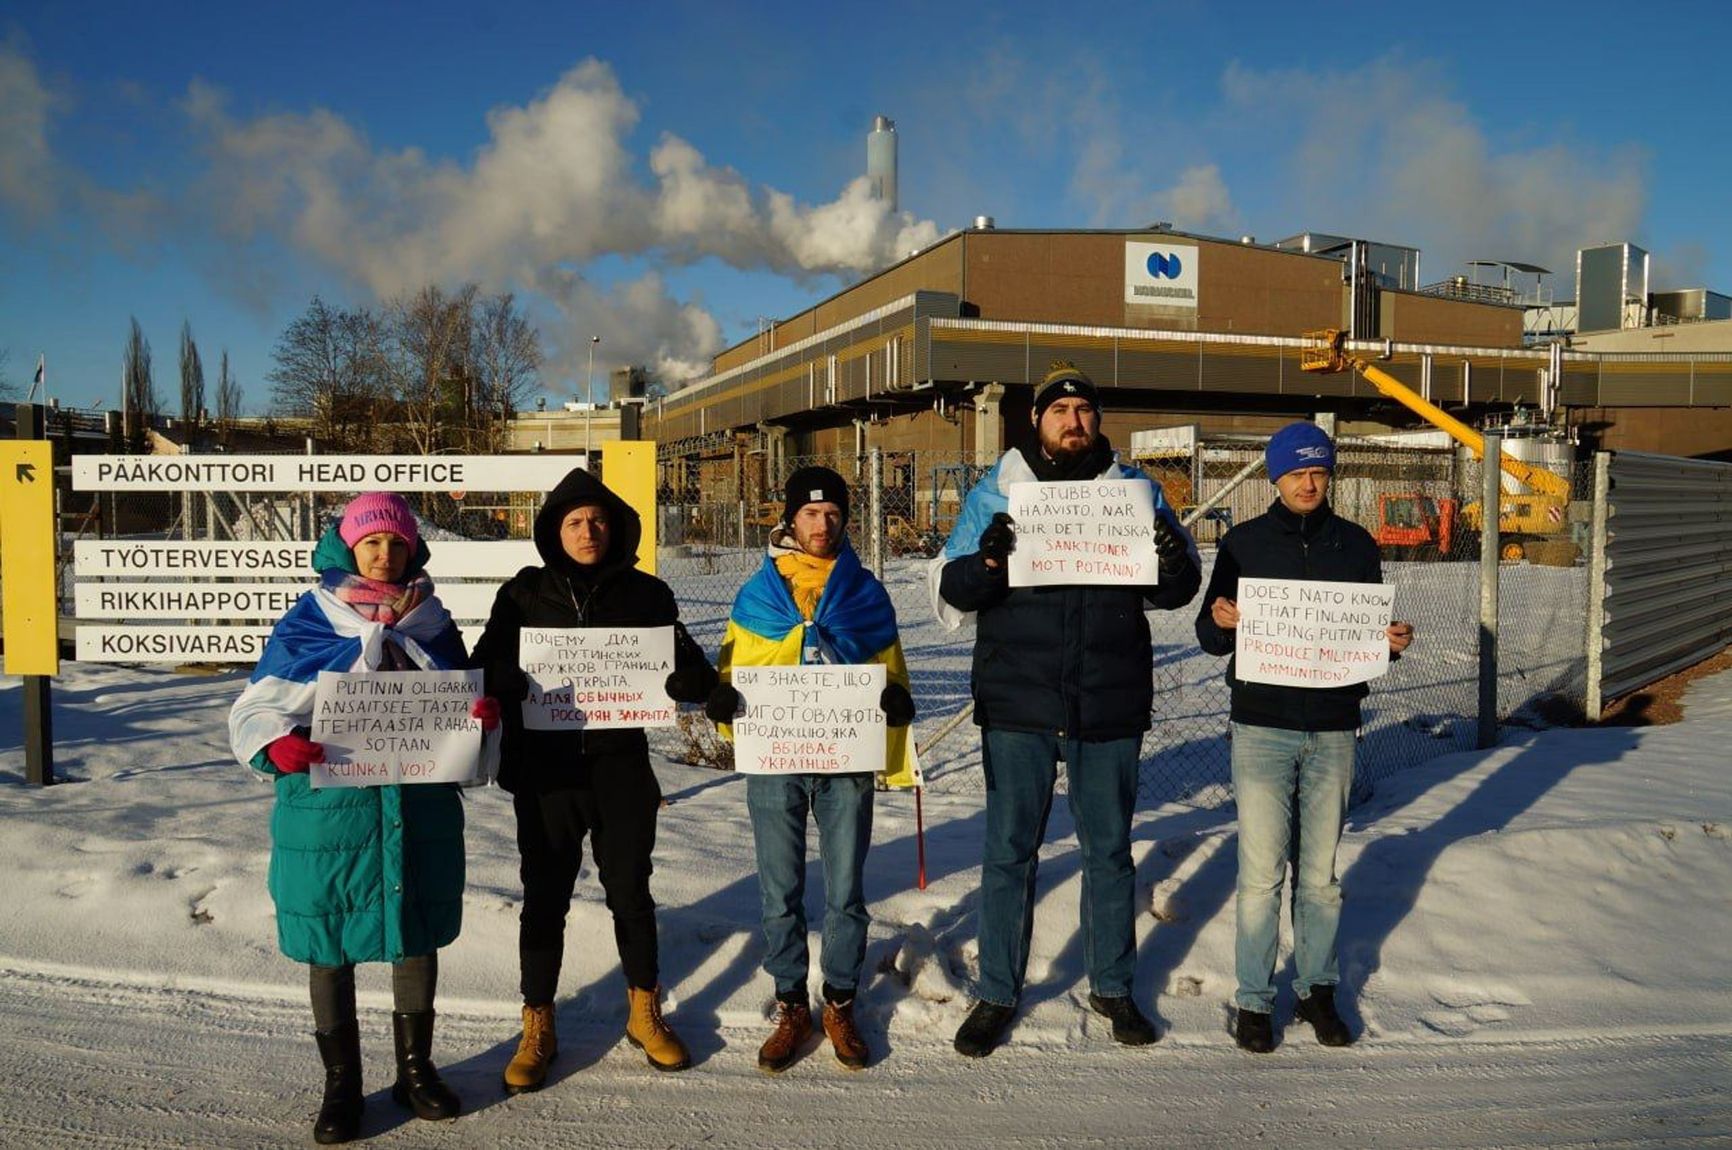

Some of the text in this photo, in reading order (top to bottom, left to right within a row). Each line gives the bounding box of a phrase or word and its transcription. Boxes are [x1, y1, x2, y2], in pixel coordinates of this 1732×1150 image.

[98, 457, 464, 482] PÄÄKONTTORI HEAD OFFICE
[1040, 485, 1127, 501] STUBB OCH
[1055, 523, 1085, 535] DET
[1098, 522, 1150, 537] FINSKA
[1045, 538, 1129, 557] SANKTIONER
[101, 545, 314, 568] TYÖTERVEYSASE
[1031, 559, 1141, 579] MOT POTANIN?
[1244, 584, 1391, 607] DOES NATO KNOW
[1258, 603, 1389, 626] THAT FINLAND IS
[1241, 619, 1386, 642] HELPING PUTIN TO
[102, 634, 270, 654] KOKSIVARAST
[524, 631, 639, 647] ПОЧЕМУ ДЛЯ
[558, 649, 641, 660] ПУТИНСКИХ
[1244, 638, 1381, 663] PRODUCE MILITARY
[526, 659, 670, 675] ДРУЖКОВ ГРАНИЦА
[1259, 662, 1350, 682] AMMUNITION?
[737, 671, 759, 685] ВИ
[843, 671, 872, 687] ЩО
[336, 680, 478, 695] PUTININ OLIGARKKI
[529, 691, 644, 706] А ДЛЯ ОБЫЧНЫХ
[788, 690, 822, 703] ТУТ
[321, 699, 412, 715] ANSAITSEE
[551, 708, 611, 722] РОССИЯН
[318, 716, 480, 735] TEHTAASTA RAHAA
[831, 727, 858, 739] ЯКА
[772, 741, 838, 755] ВБИВАЄ
[328, 760, 436, 777] KUINKA VOI?
